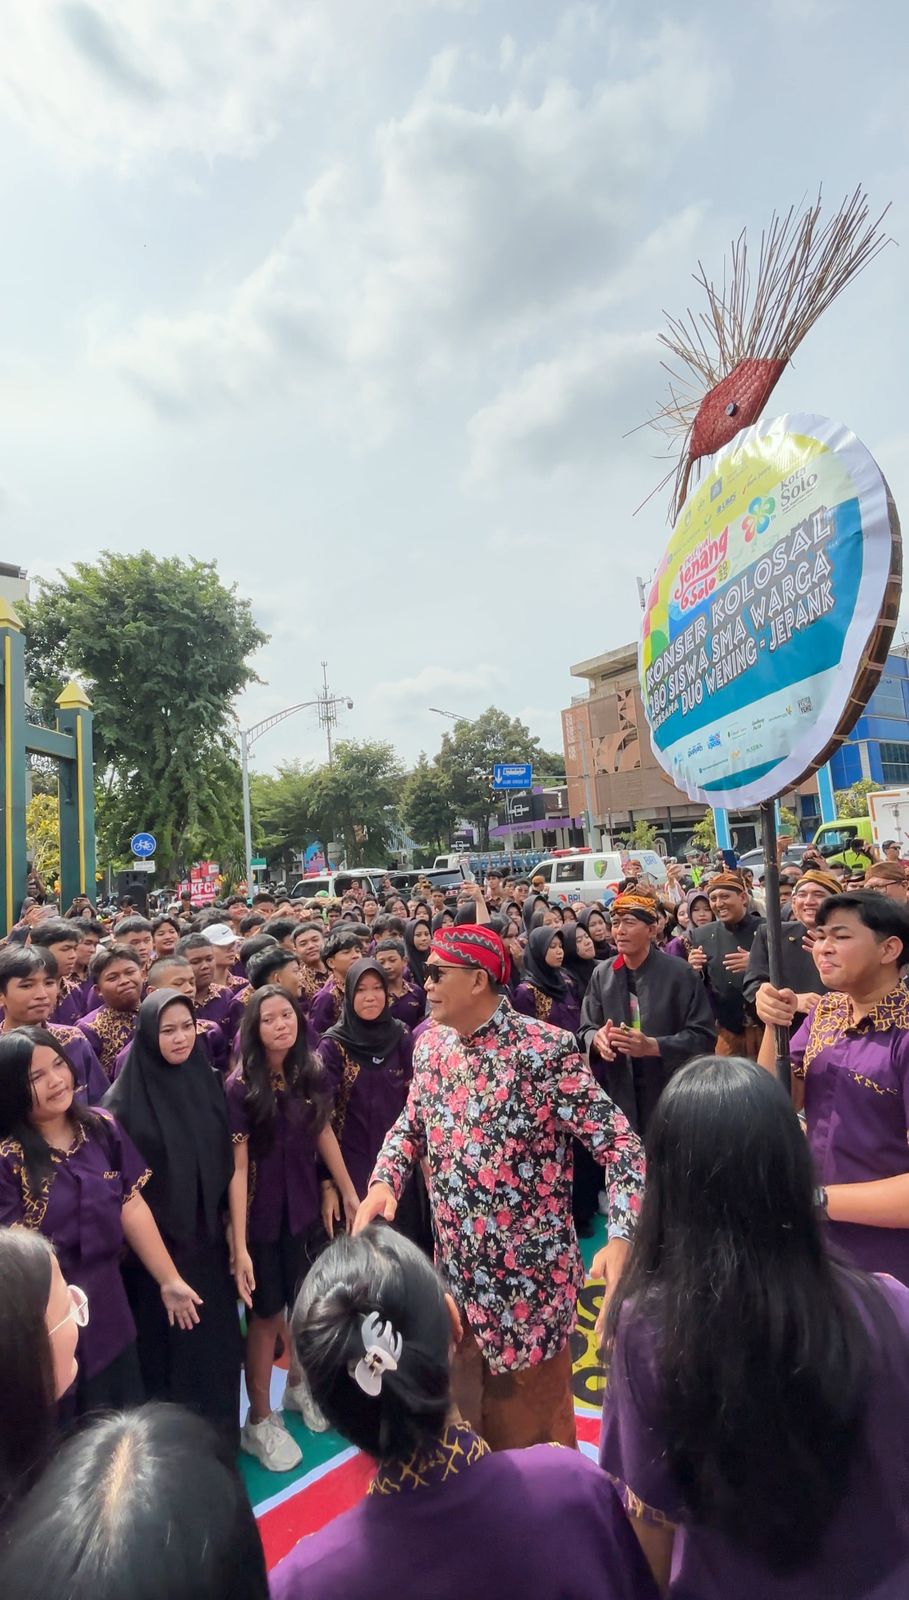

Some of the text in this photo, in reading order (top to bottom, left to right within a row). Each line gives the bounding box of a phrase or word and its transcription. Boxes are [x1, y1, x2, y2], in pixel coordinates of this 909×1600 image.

[780, 473, 818, 507] Solo
[646, 513, 832, 692] KONSER KOLOSAL
[668, 647, 709, 700] SISWA
[711, 615, 747, 663] SMA
[750, 549, 832, 629] WARGA
[681, 679, 703, 716] DUO
[705, 636, 758, 696] WENING
[769, 580, 836, 651] JEPANK
[191, 882, 211, 895] KFC
